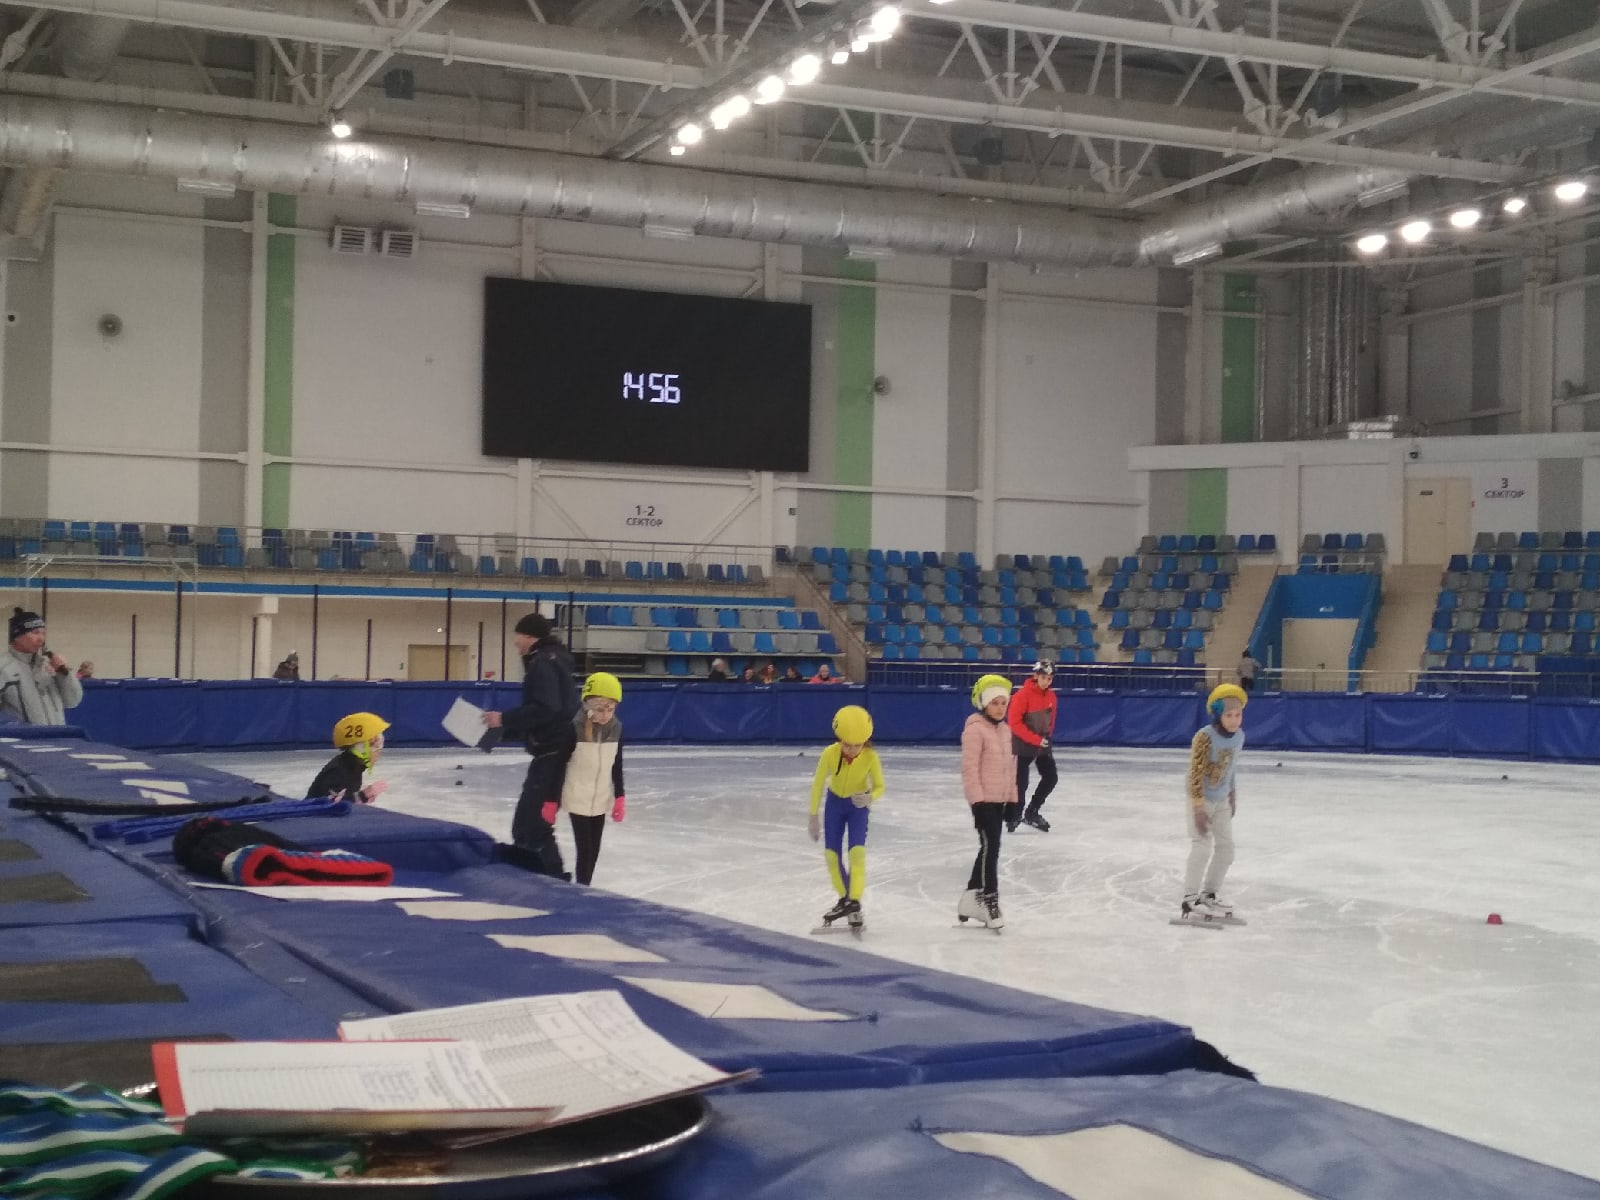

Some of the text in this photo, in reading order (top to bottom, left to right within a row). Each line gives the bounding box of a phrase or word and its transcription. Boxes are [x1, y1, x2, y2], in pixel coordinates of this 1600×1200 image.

[1501, 477, 1509, 489] 3
[635, 504, 655, 517] 1-2
[625, 517, 663, 527] СЕКТОР
[344, 725, 363, 738] 28
